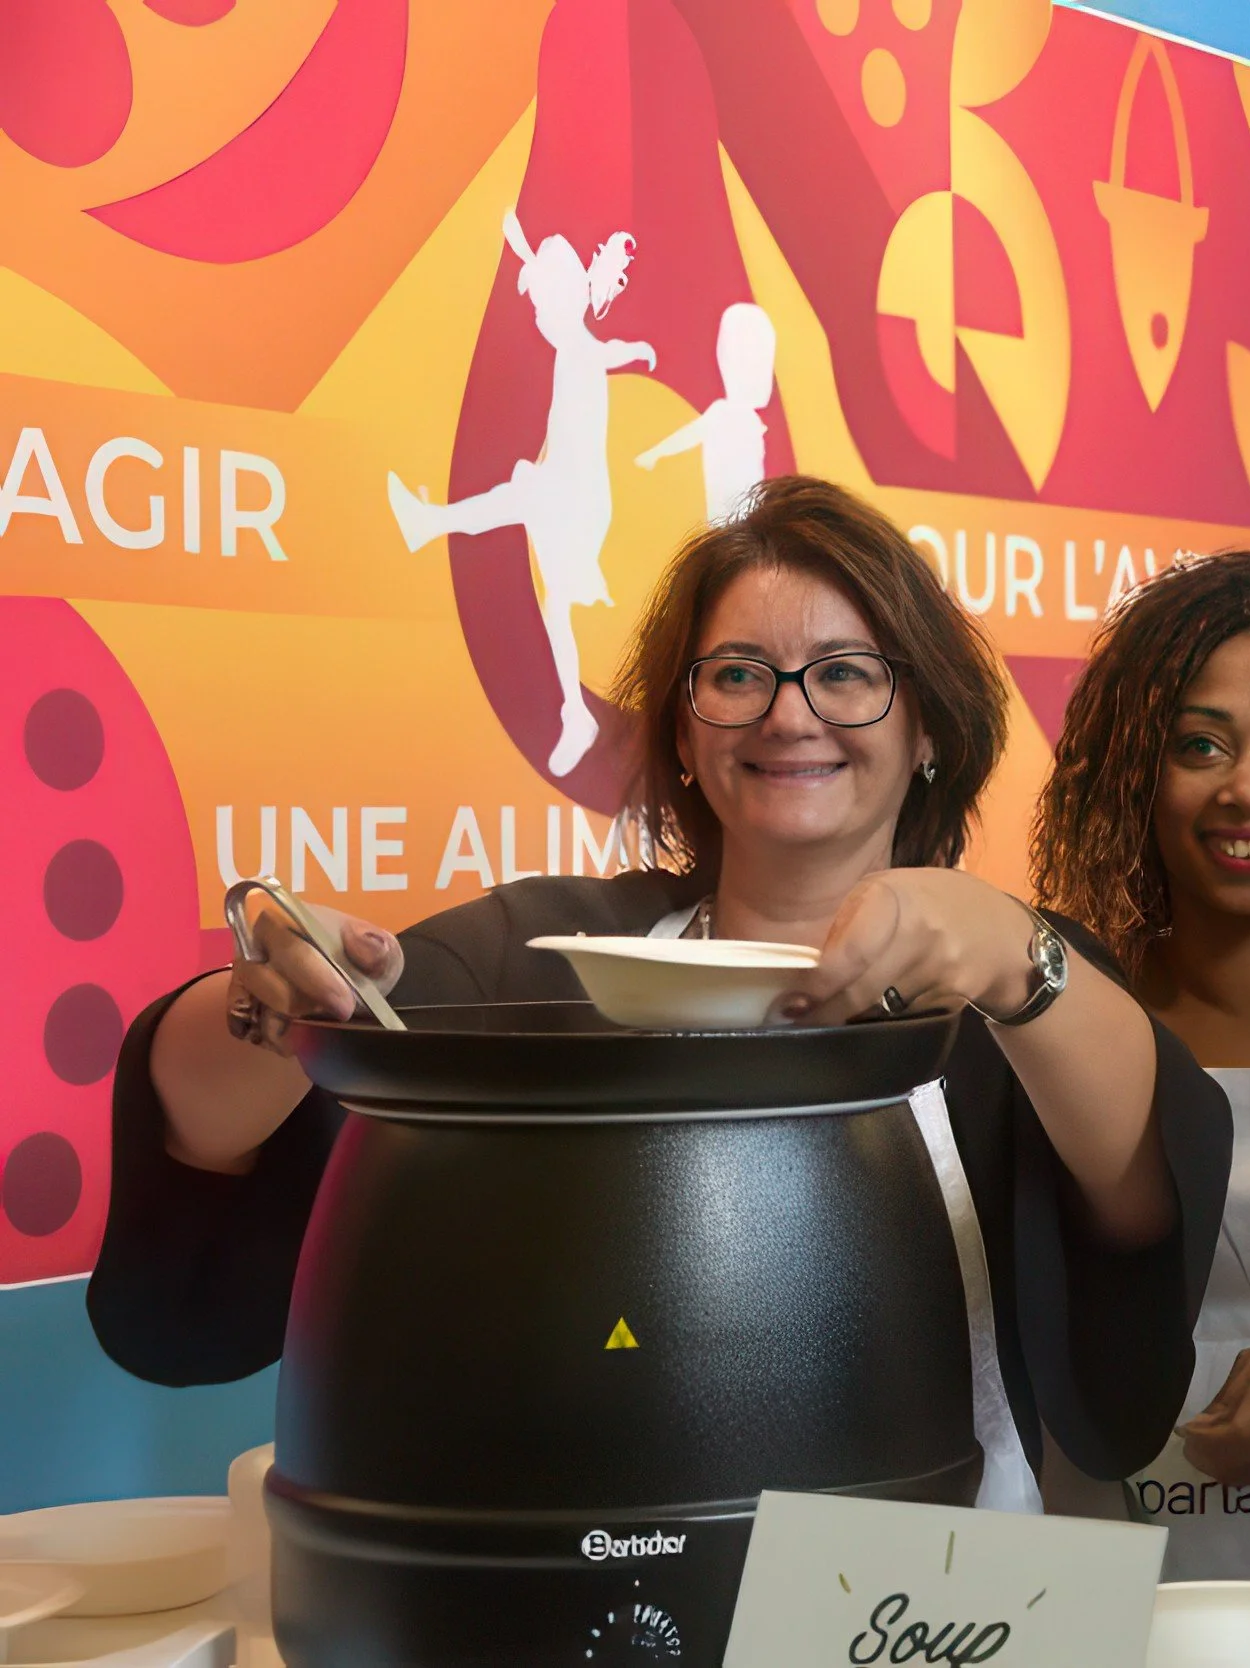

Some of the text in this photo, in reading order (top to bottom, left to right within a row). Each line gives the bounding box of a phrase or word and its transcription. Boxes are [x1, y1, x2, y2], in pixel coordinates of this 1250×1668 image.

[0, 426, 289, 562] AGIR
[215, 804, 408, 893] UNE
[848, 1592, 1011, 1668] Soup
